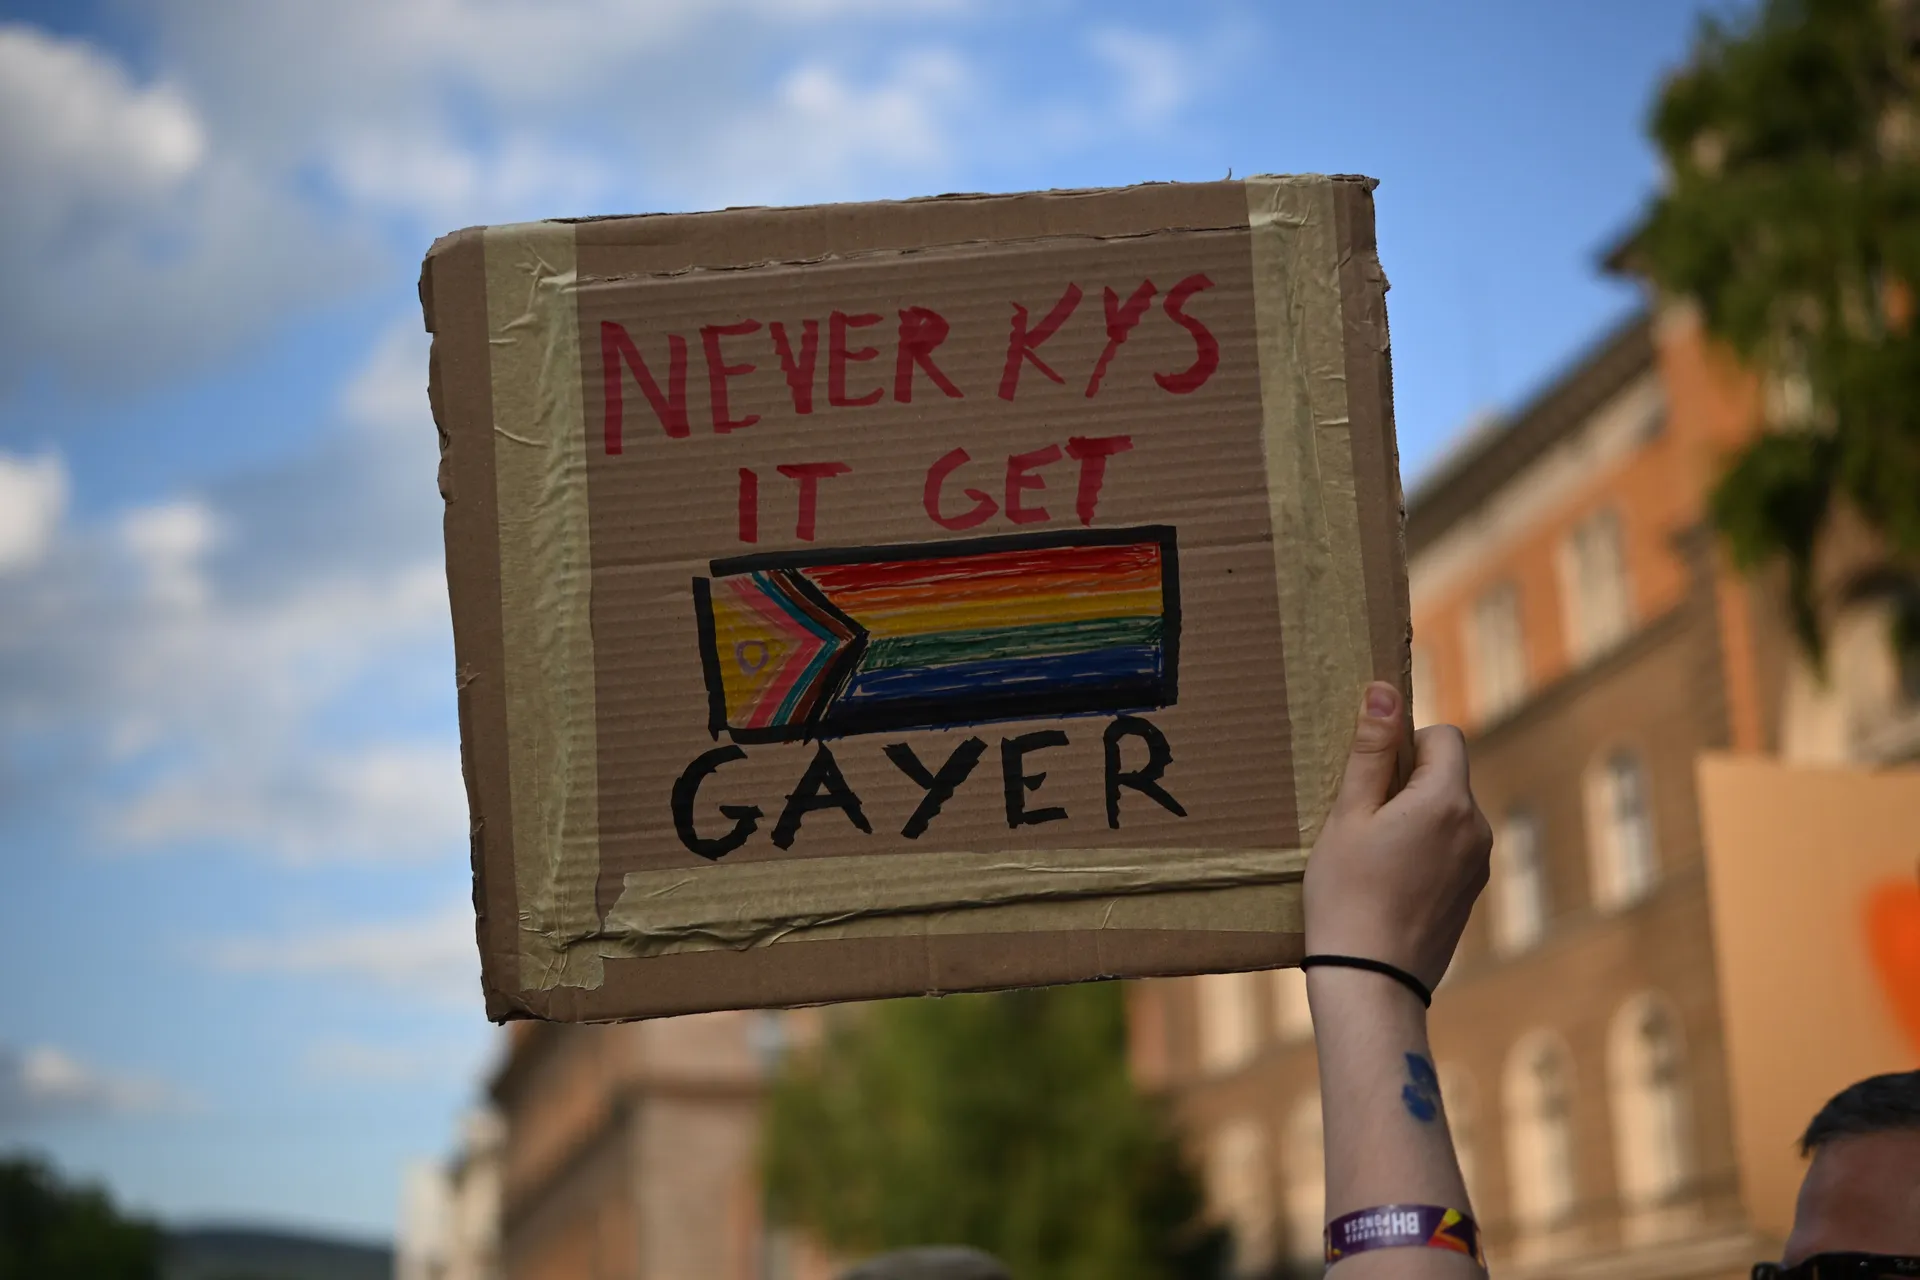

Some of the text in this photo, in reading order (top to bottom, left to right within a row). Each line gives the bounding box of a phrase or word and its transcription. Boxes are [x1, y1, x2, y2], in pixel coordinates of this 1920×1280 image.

[600, 273, 1220, 455] NEVER KYS
[738, 435, 1134, 543] IT GET
[671, 713, 1188, 861] GAYER
[1391, 1211, 1420, 1236] BH
